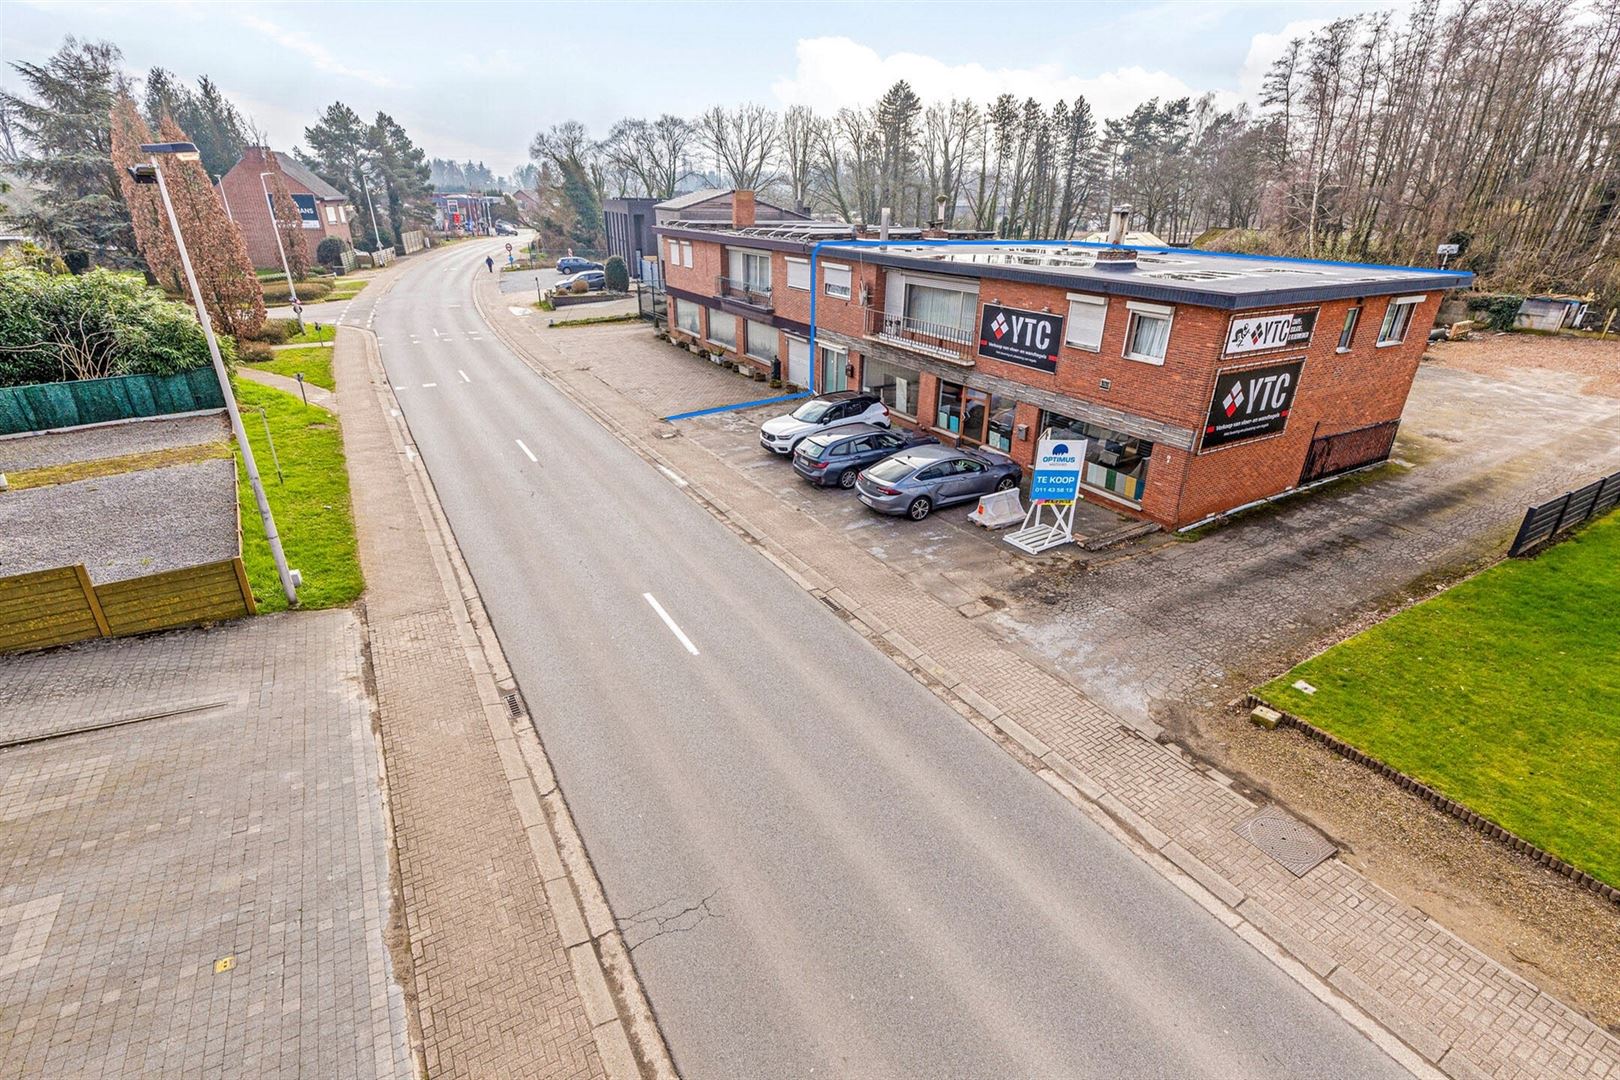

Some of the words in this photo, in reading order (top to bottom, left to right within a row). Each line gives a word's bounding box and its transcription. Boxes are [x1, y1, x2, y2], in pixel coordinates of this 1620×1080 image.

[1011, 315, 1052, 350] YTC
[1263, 320, 1290, 343] YTC
[1246, 373, 1290, 414] YTC
[1037, 476, 1048, 484] TE
[1049, 476, 1075, 484] KOOP
